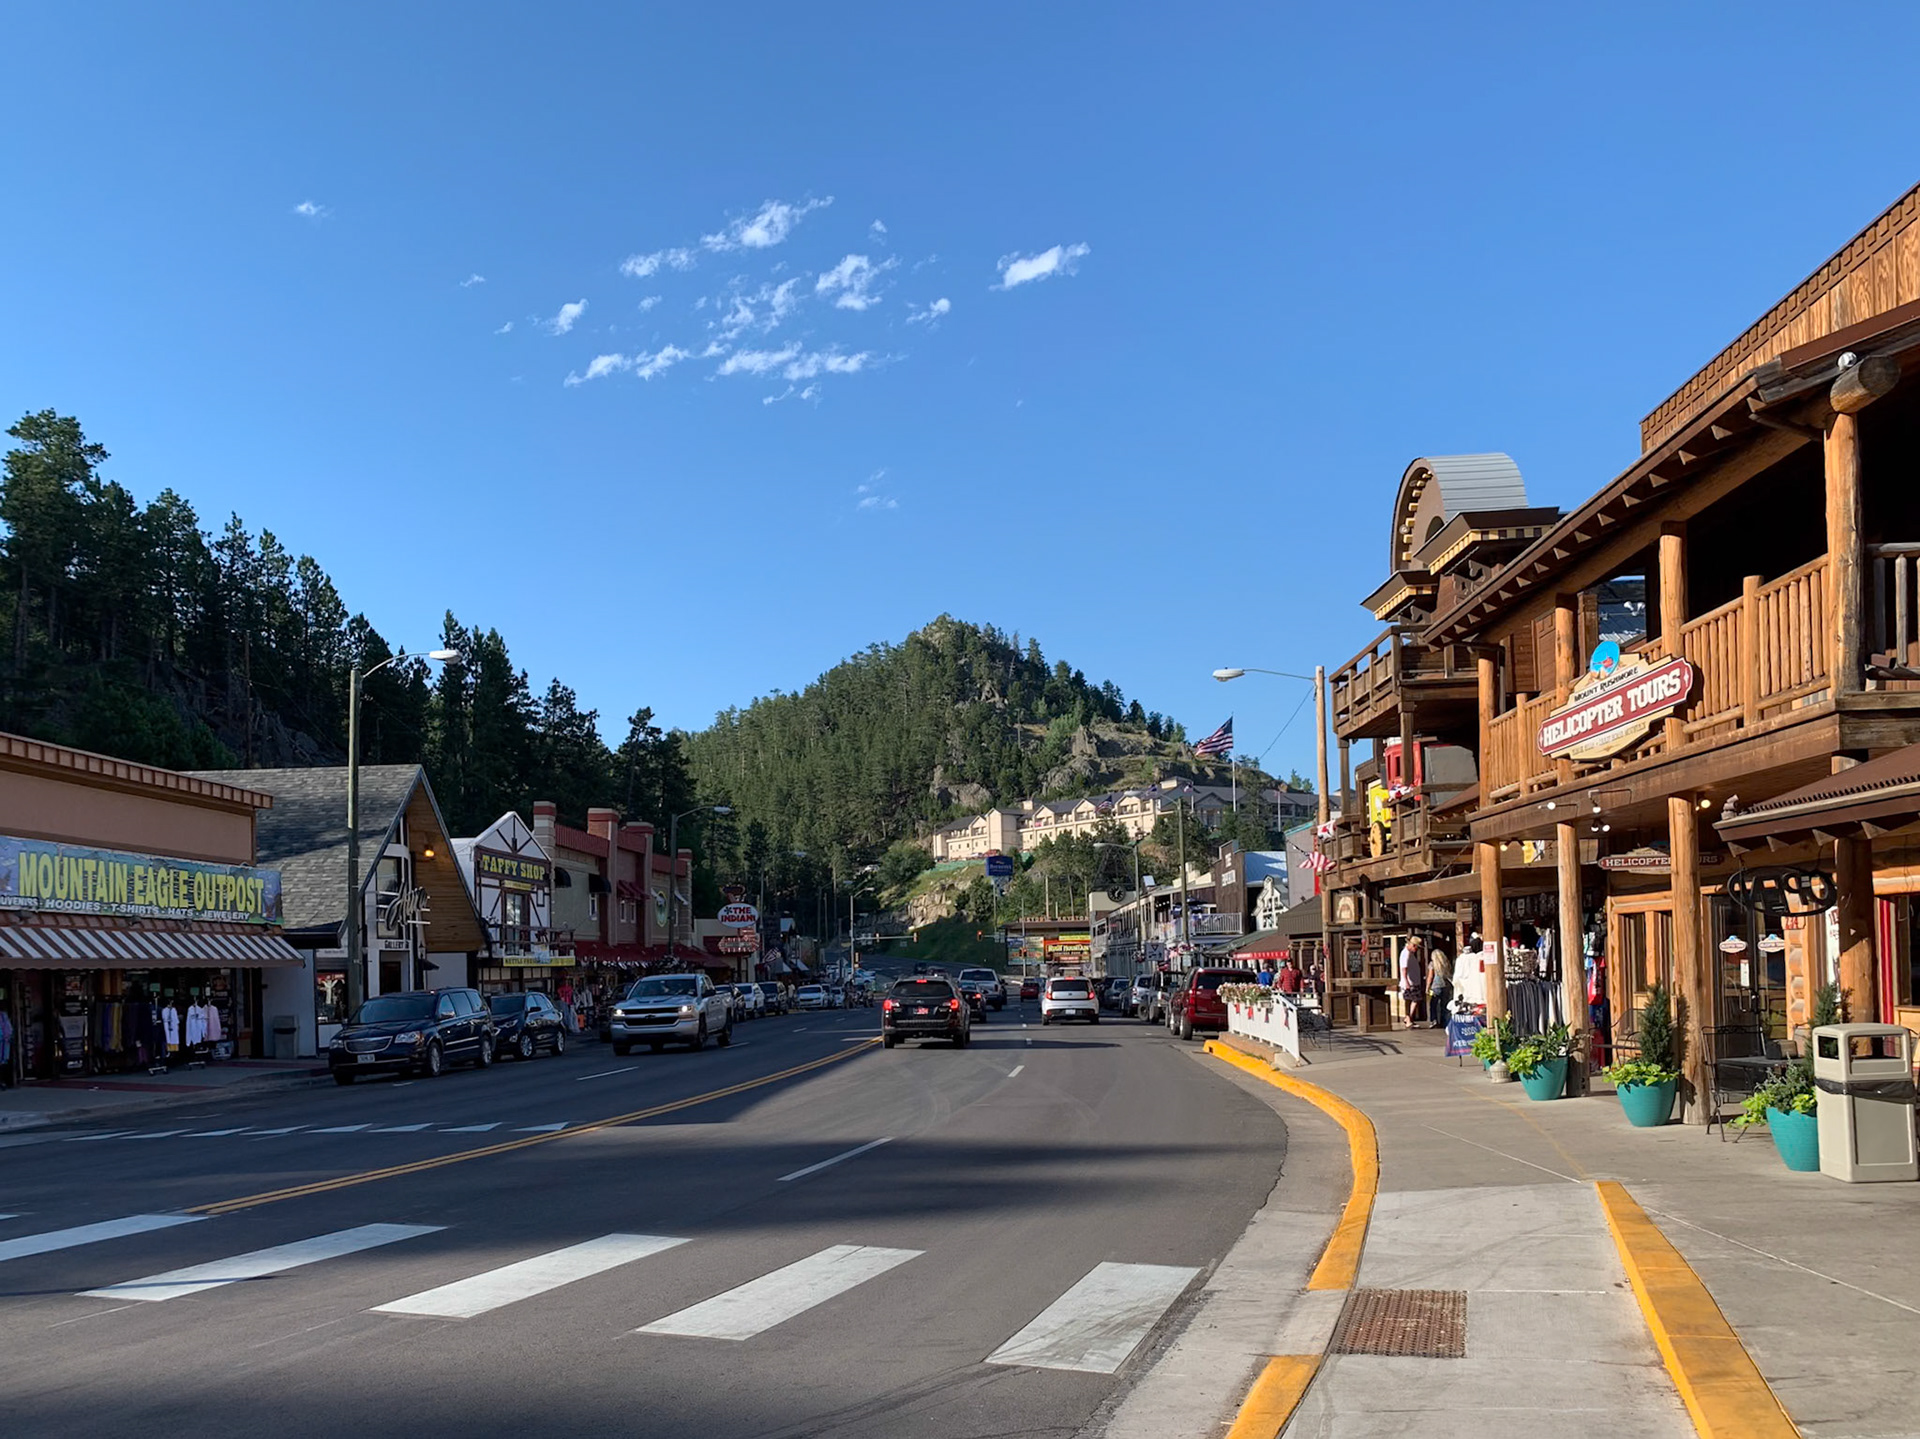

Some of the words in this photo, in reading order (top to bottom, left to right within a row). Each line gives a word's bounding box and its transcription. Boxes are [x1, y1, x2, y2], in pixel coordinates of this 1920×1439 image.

[1574, 685, 1598, 702] MOUNT
[1600, 666, 1639, 692] RUSHMORE
[1543, 694, 1624, 748] HELICOPTER
[1626, 667, 1682, 712] TOURS
[19, 852, 128, 904] MOUNTAIN
[134, 865, 189, 908] EAGLE
[194, 872, 264, 914] OUTPOST
[483, 855, 518, 876] TAFFY
[520, 862, 546, 881] SHOP
[46, 899, 101, 912] HOODIES
[111, 904, 160, 916] T-SHIRTS
[168, 908, 194, 917] HATS
